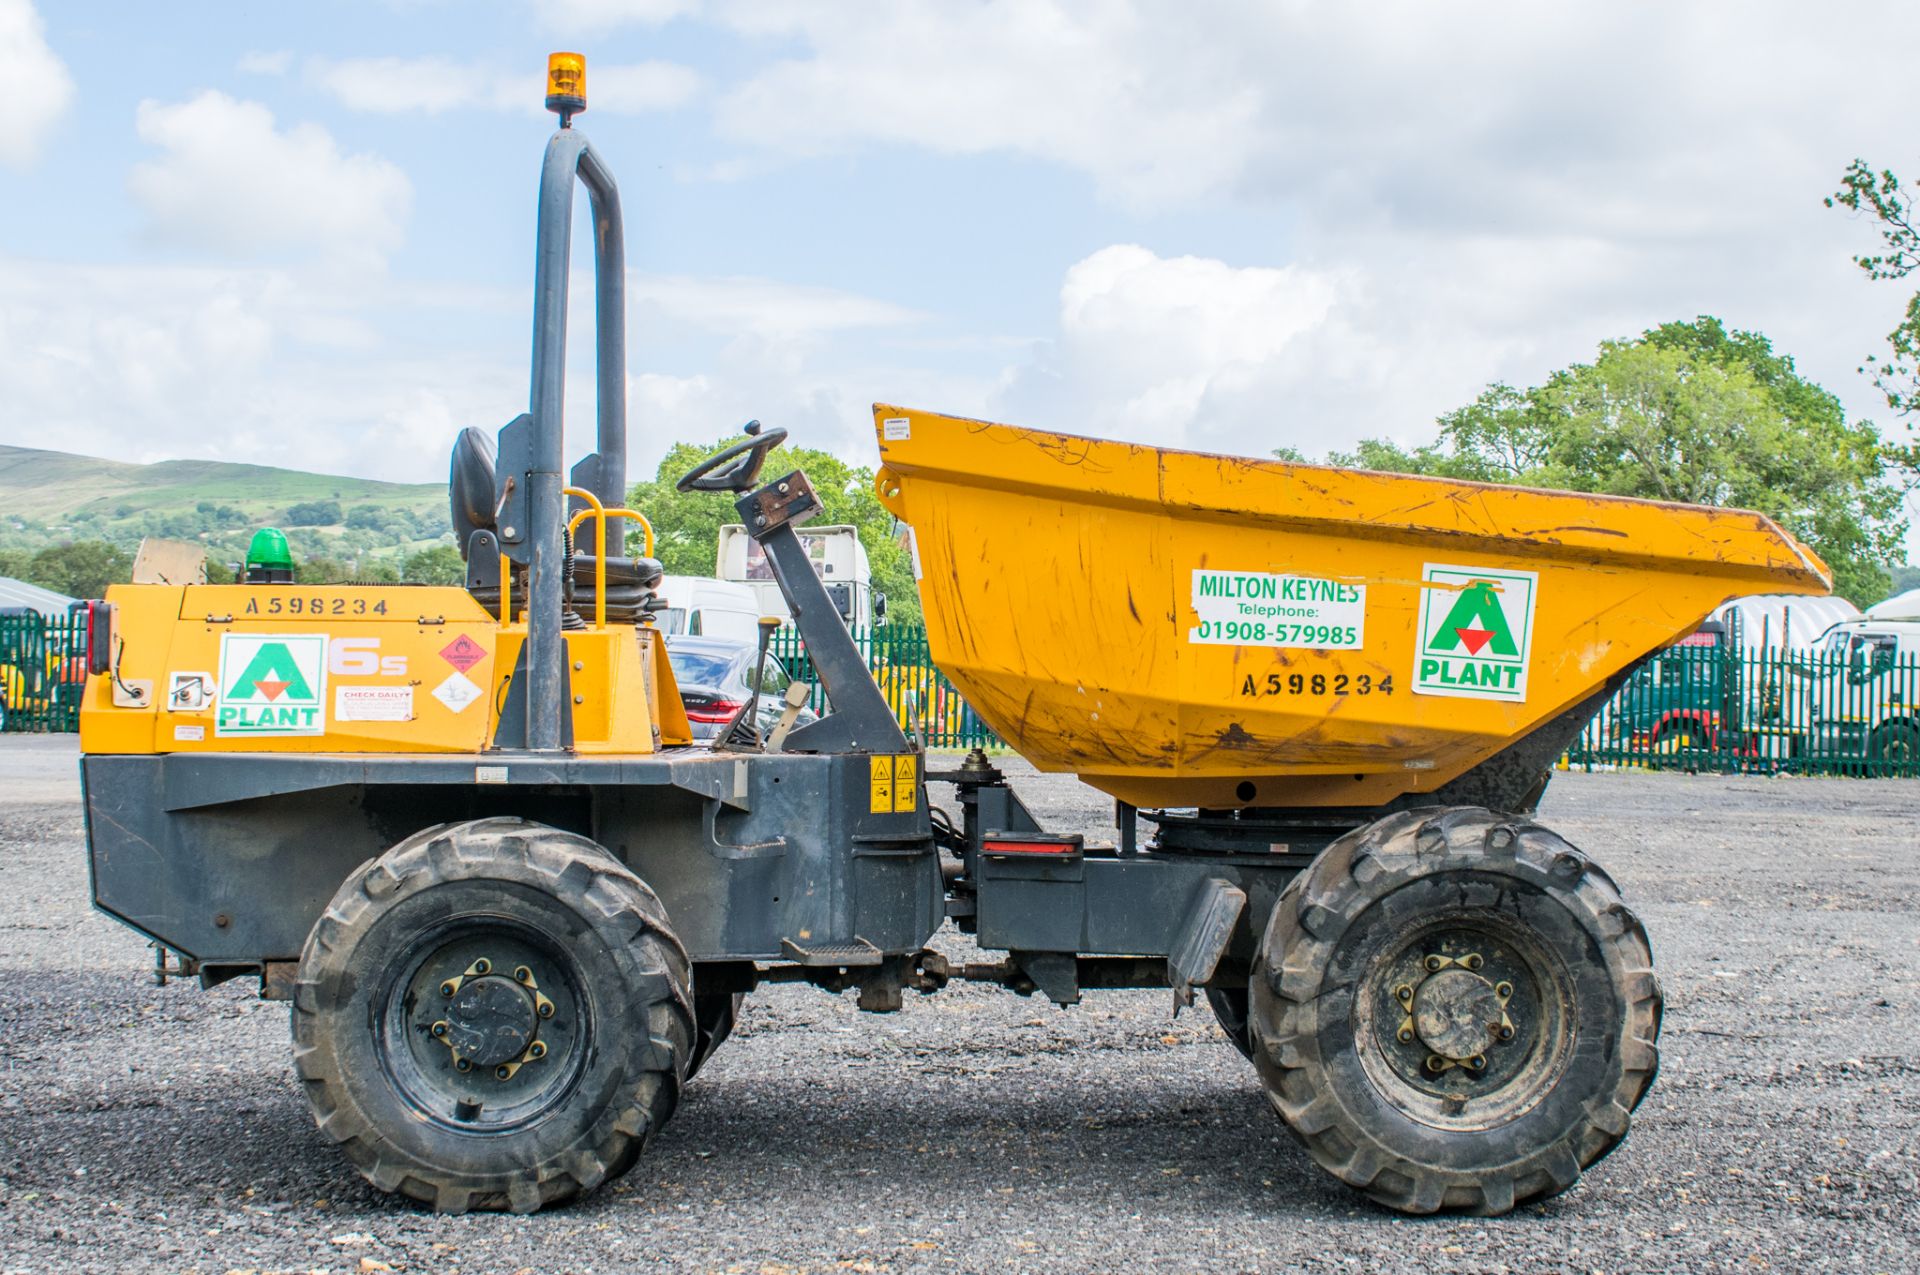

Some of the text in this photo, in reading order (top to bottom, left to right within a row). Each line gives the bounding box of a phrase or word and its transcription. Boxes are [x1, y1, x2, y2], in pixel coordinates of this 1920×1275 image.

[1199, 575, 1360, 603] MILTON KEYNES
[245, 597, 387, 616] A598234
[1237, 602, 1320, 619] Telephone:
[1197, 620, 1357, 645] 01908-579985
[328, 637, 408, 676] 6s
[1241, 673, 1394, 697] A598234
[1419, 658, 1523, 689] PLANT
[218, 706, 320, 727] PLANT
